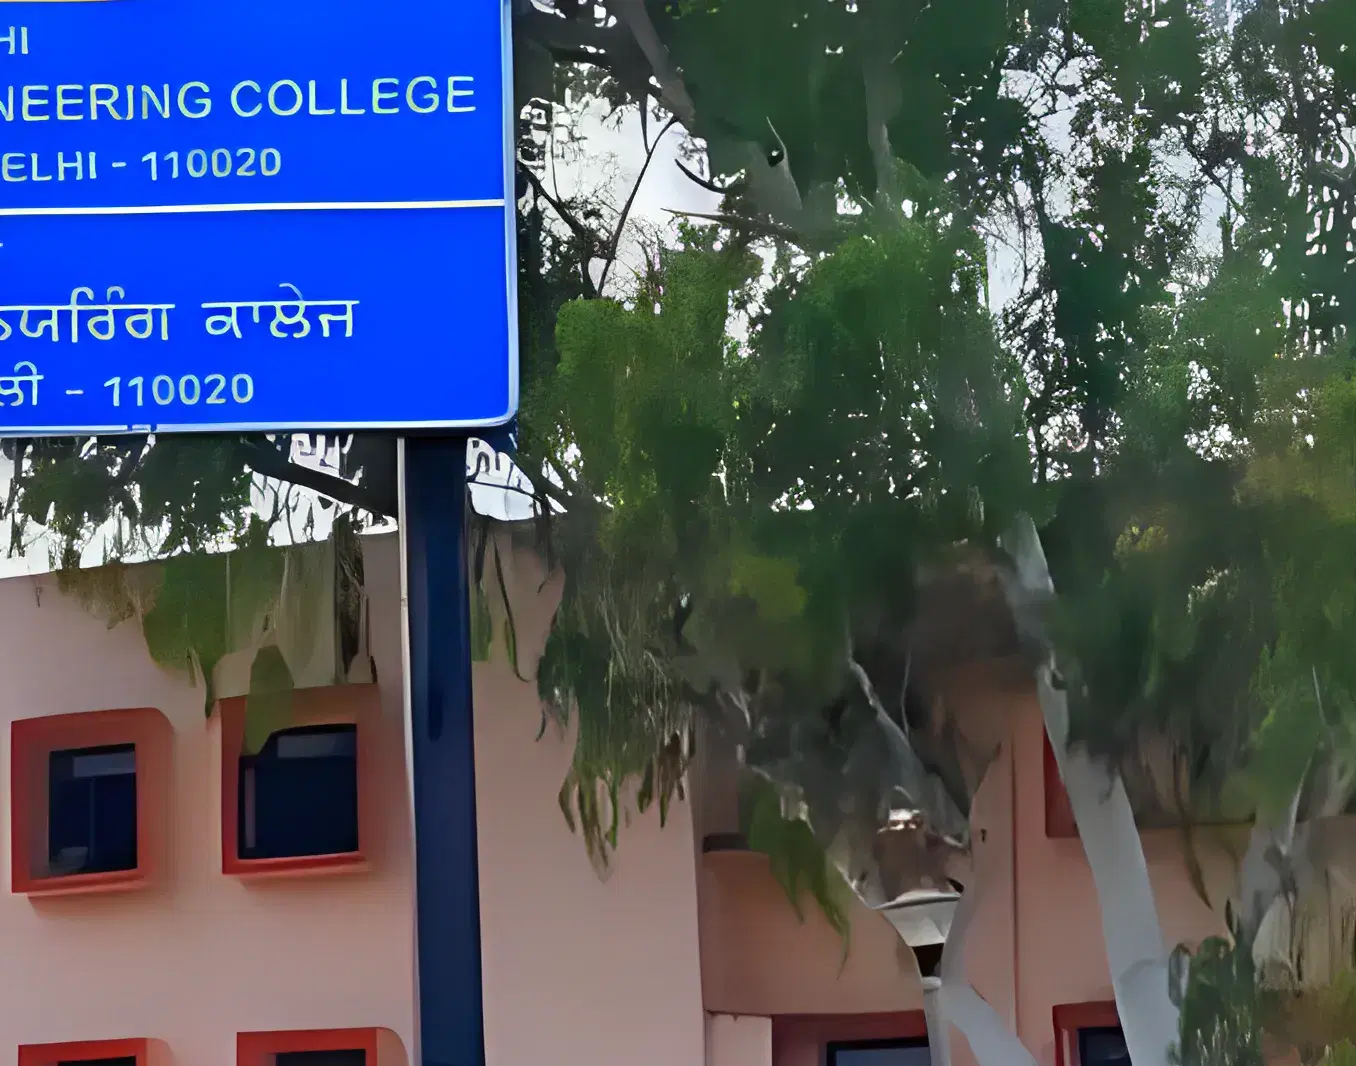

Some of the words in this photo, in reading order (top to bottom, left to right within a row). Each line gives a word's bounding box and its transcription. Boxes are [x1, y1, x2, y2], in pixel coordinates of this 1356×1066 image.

[230, 74, 477, 118] COLLEGE
[141, 146, 281, 182] 110020
[200, 282, 360, 339] ਕਾਲੇਜ
[103, 372, 255, 407] 110020
